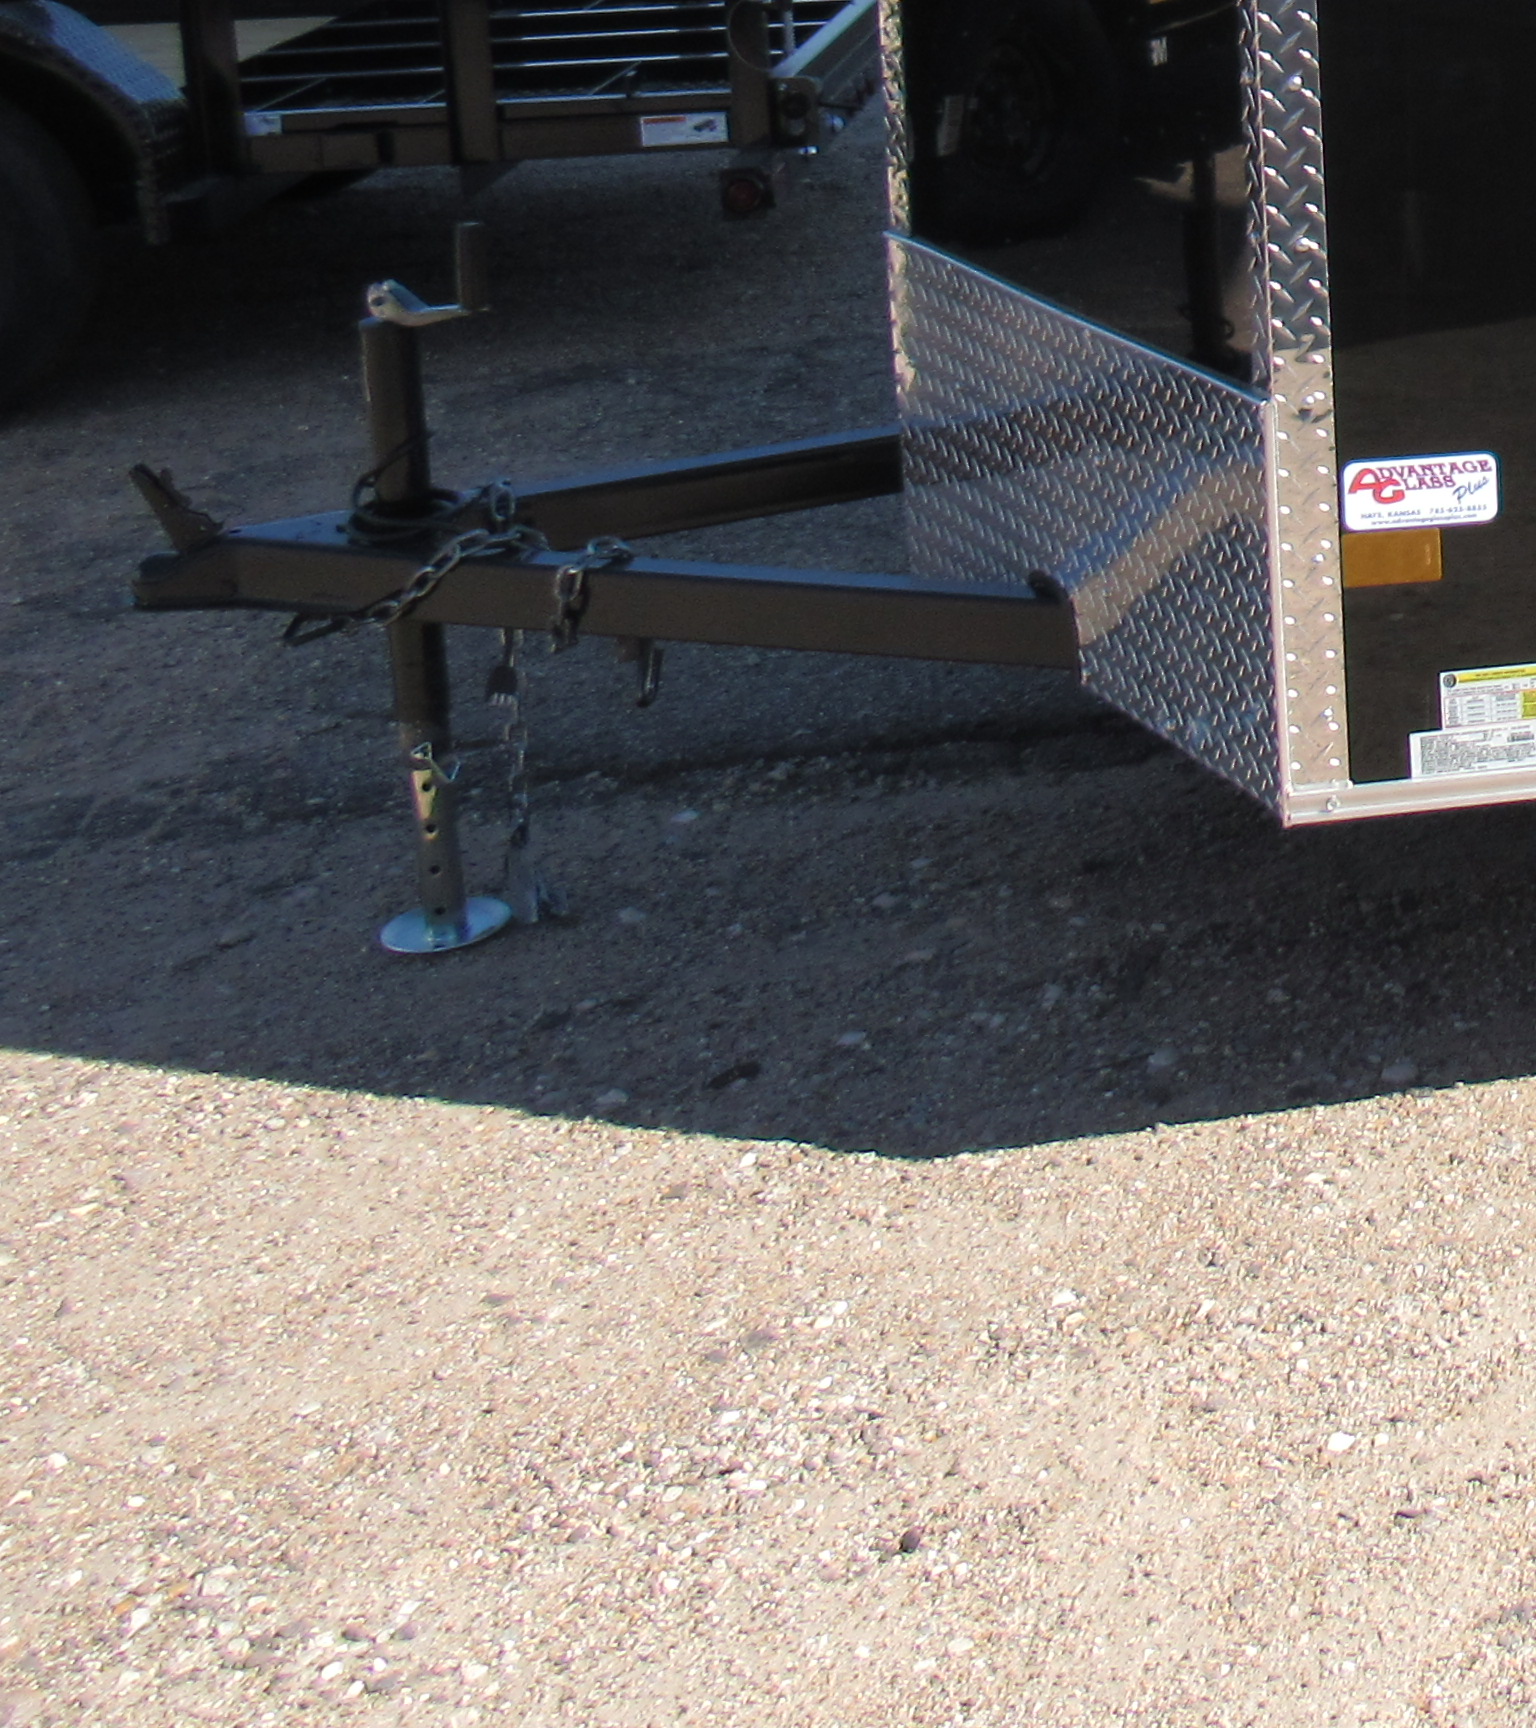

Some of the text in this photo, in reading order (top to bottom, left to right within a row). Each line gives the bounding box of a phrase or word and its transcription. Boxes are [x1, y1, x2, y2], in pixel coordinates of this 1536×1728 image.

[1348, 459, 1493, 494] ADVANTAGE
[1372, 474, 1456, 505] GLASS
[1452, 476, 1490, 504] Plus
